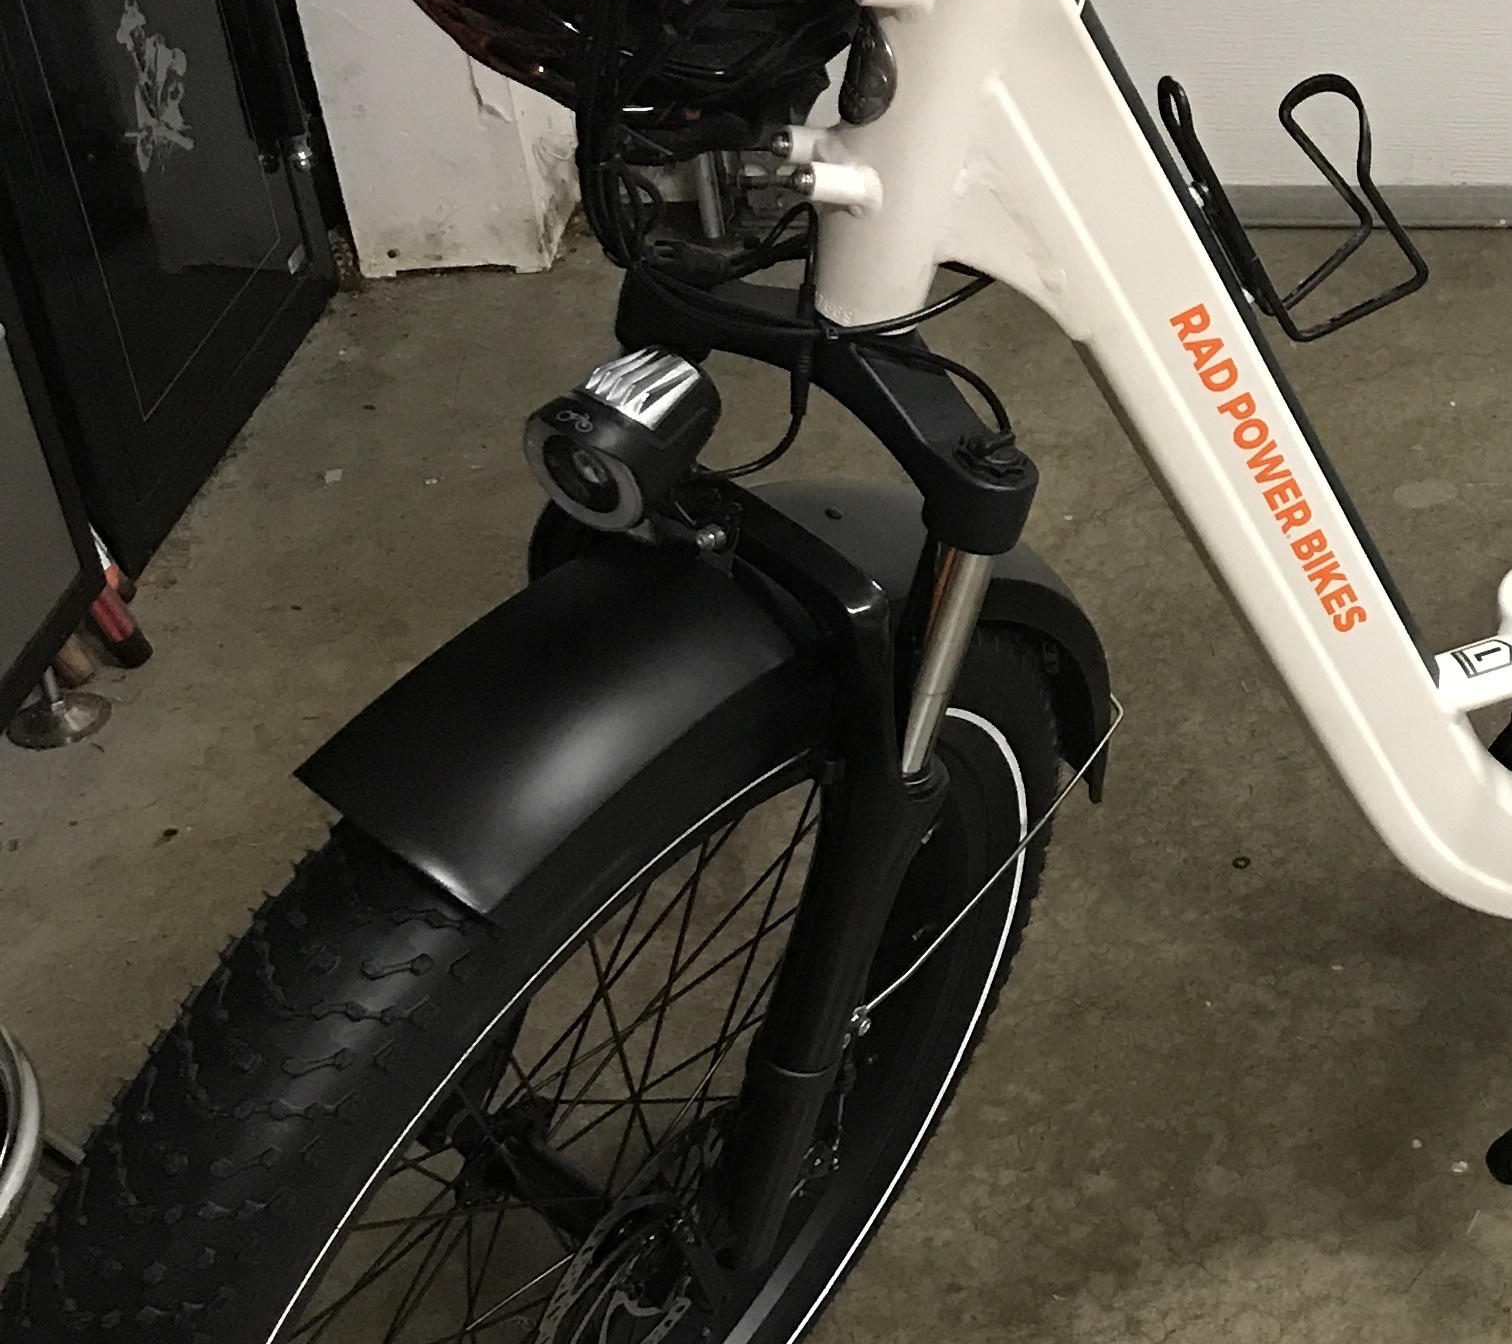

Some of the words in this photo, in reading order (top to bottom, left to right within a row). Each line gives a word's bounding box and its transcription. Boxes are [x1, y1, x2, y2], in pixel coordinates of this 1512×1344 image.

[1169, 303, 1239, 392] RAD
[1217, 391, 1312, 535] POWER
[1290, 528, 1367, 633] BIKES
